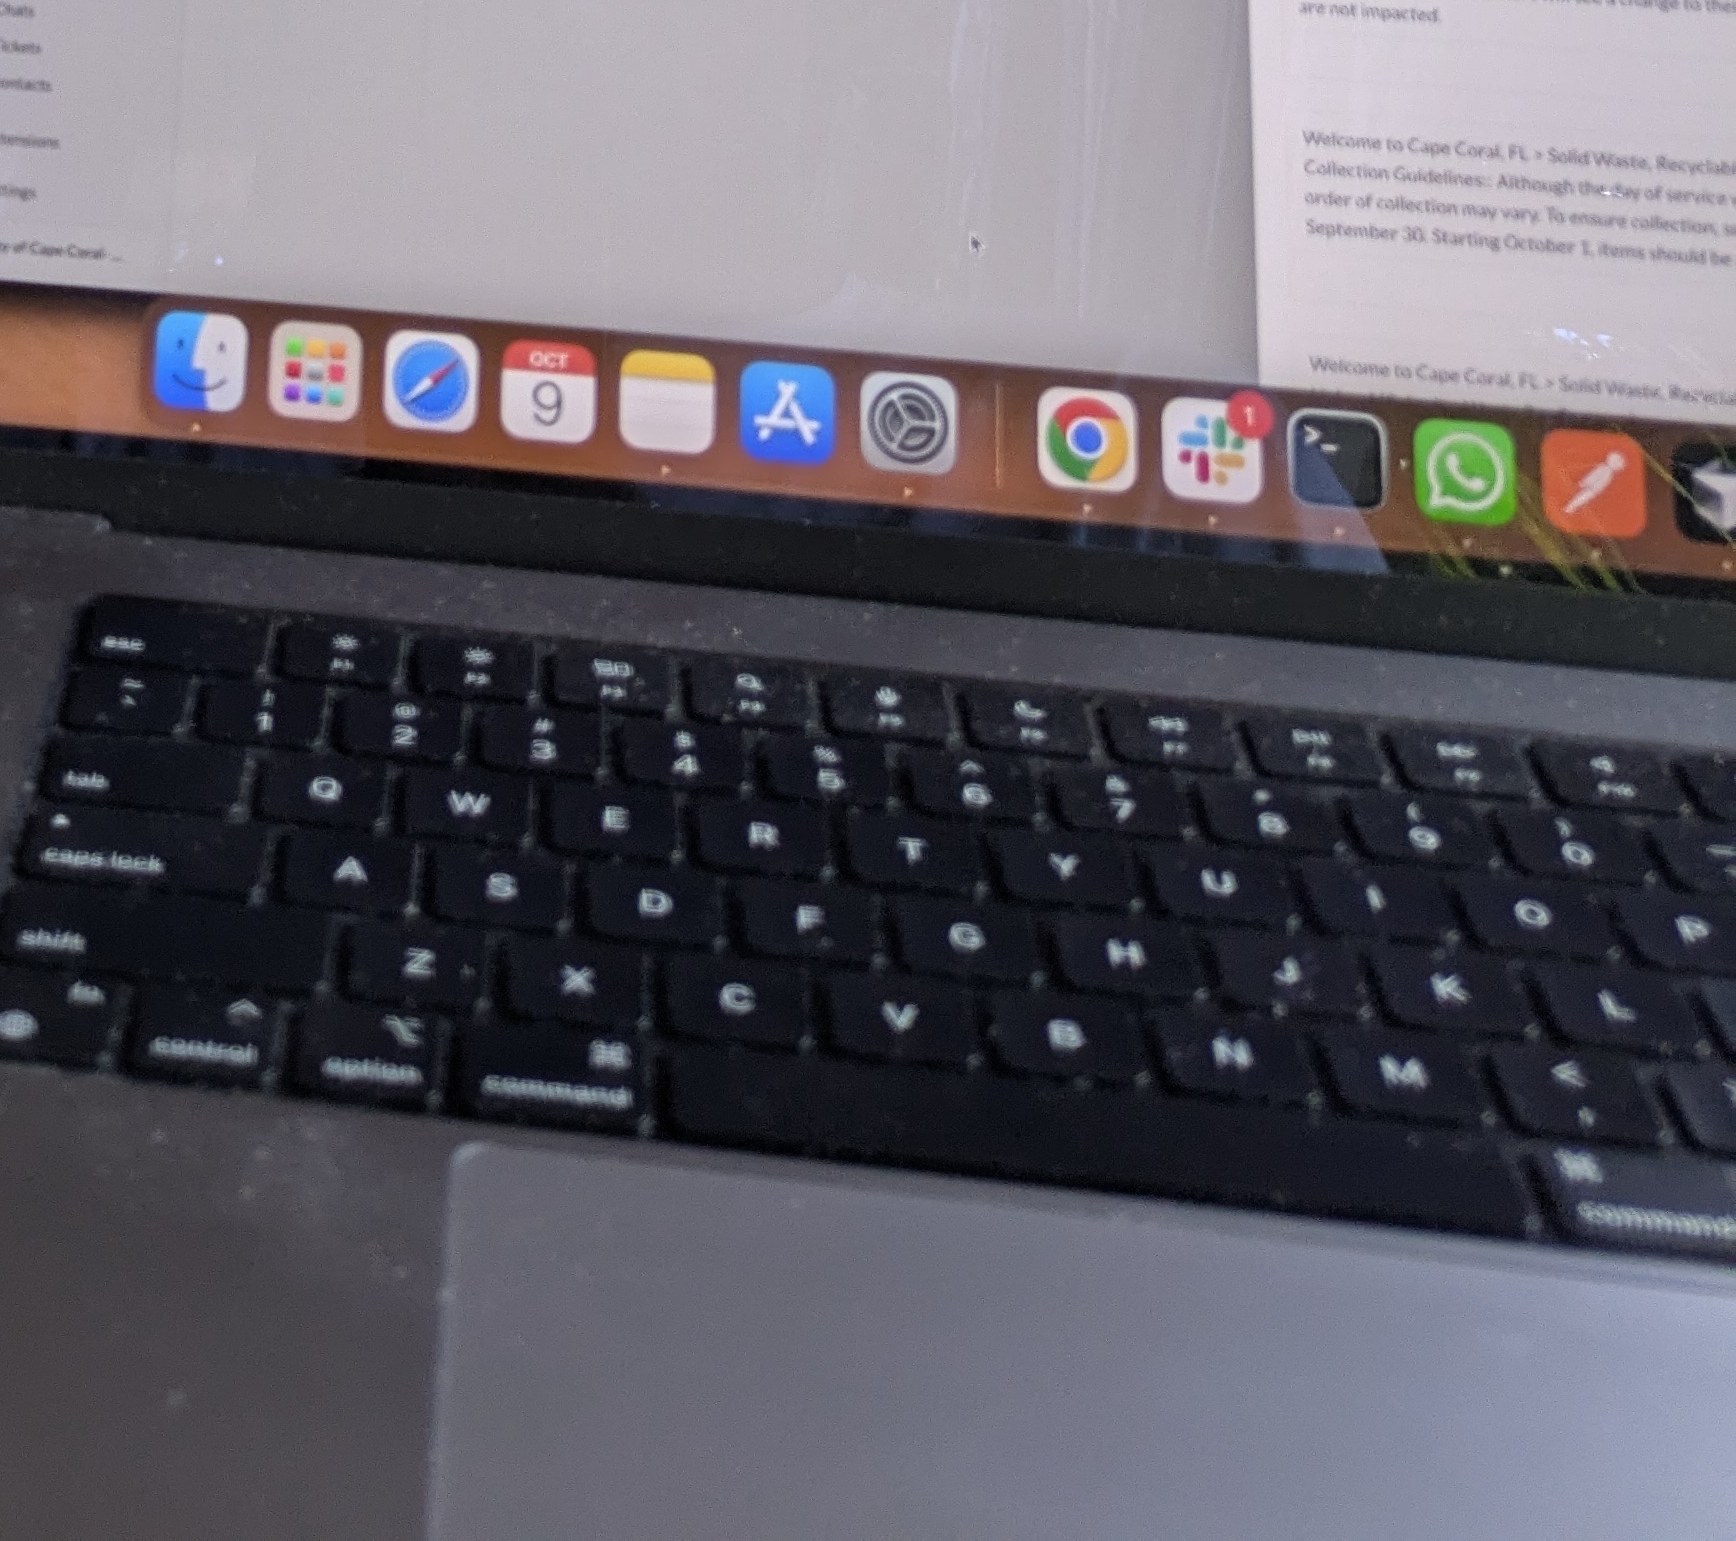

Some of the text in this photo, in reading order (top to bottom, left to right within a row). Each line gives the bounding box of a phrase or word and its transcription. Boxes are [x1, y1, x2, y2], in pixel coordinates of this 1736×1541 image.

[529, 350, 568, 368] OCT
[532, 380, 562, 426] 9
[309, 777, 492, 817] Q W
[334, 855, 366, 882] A
